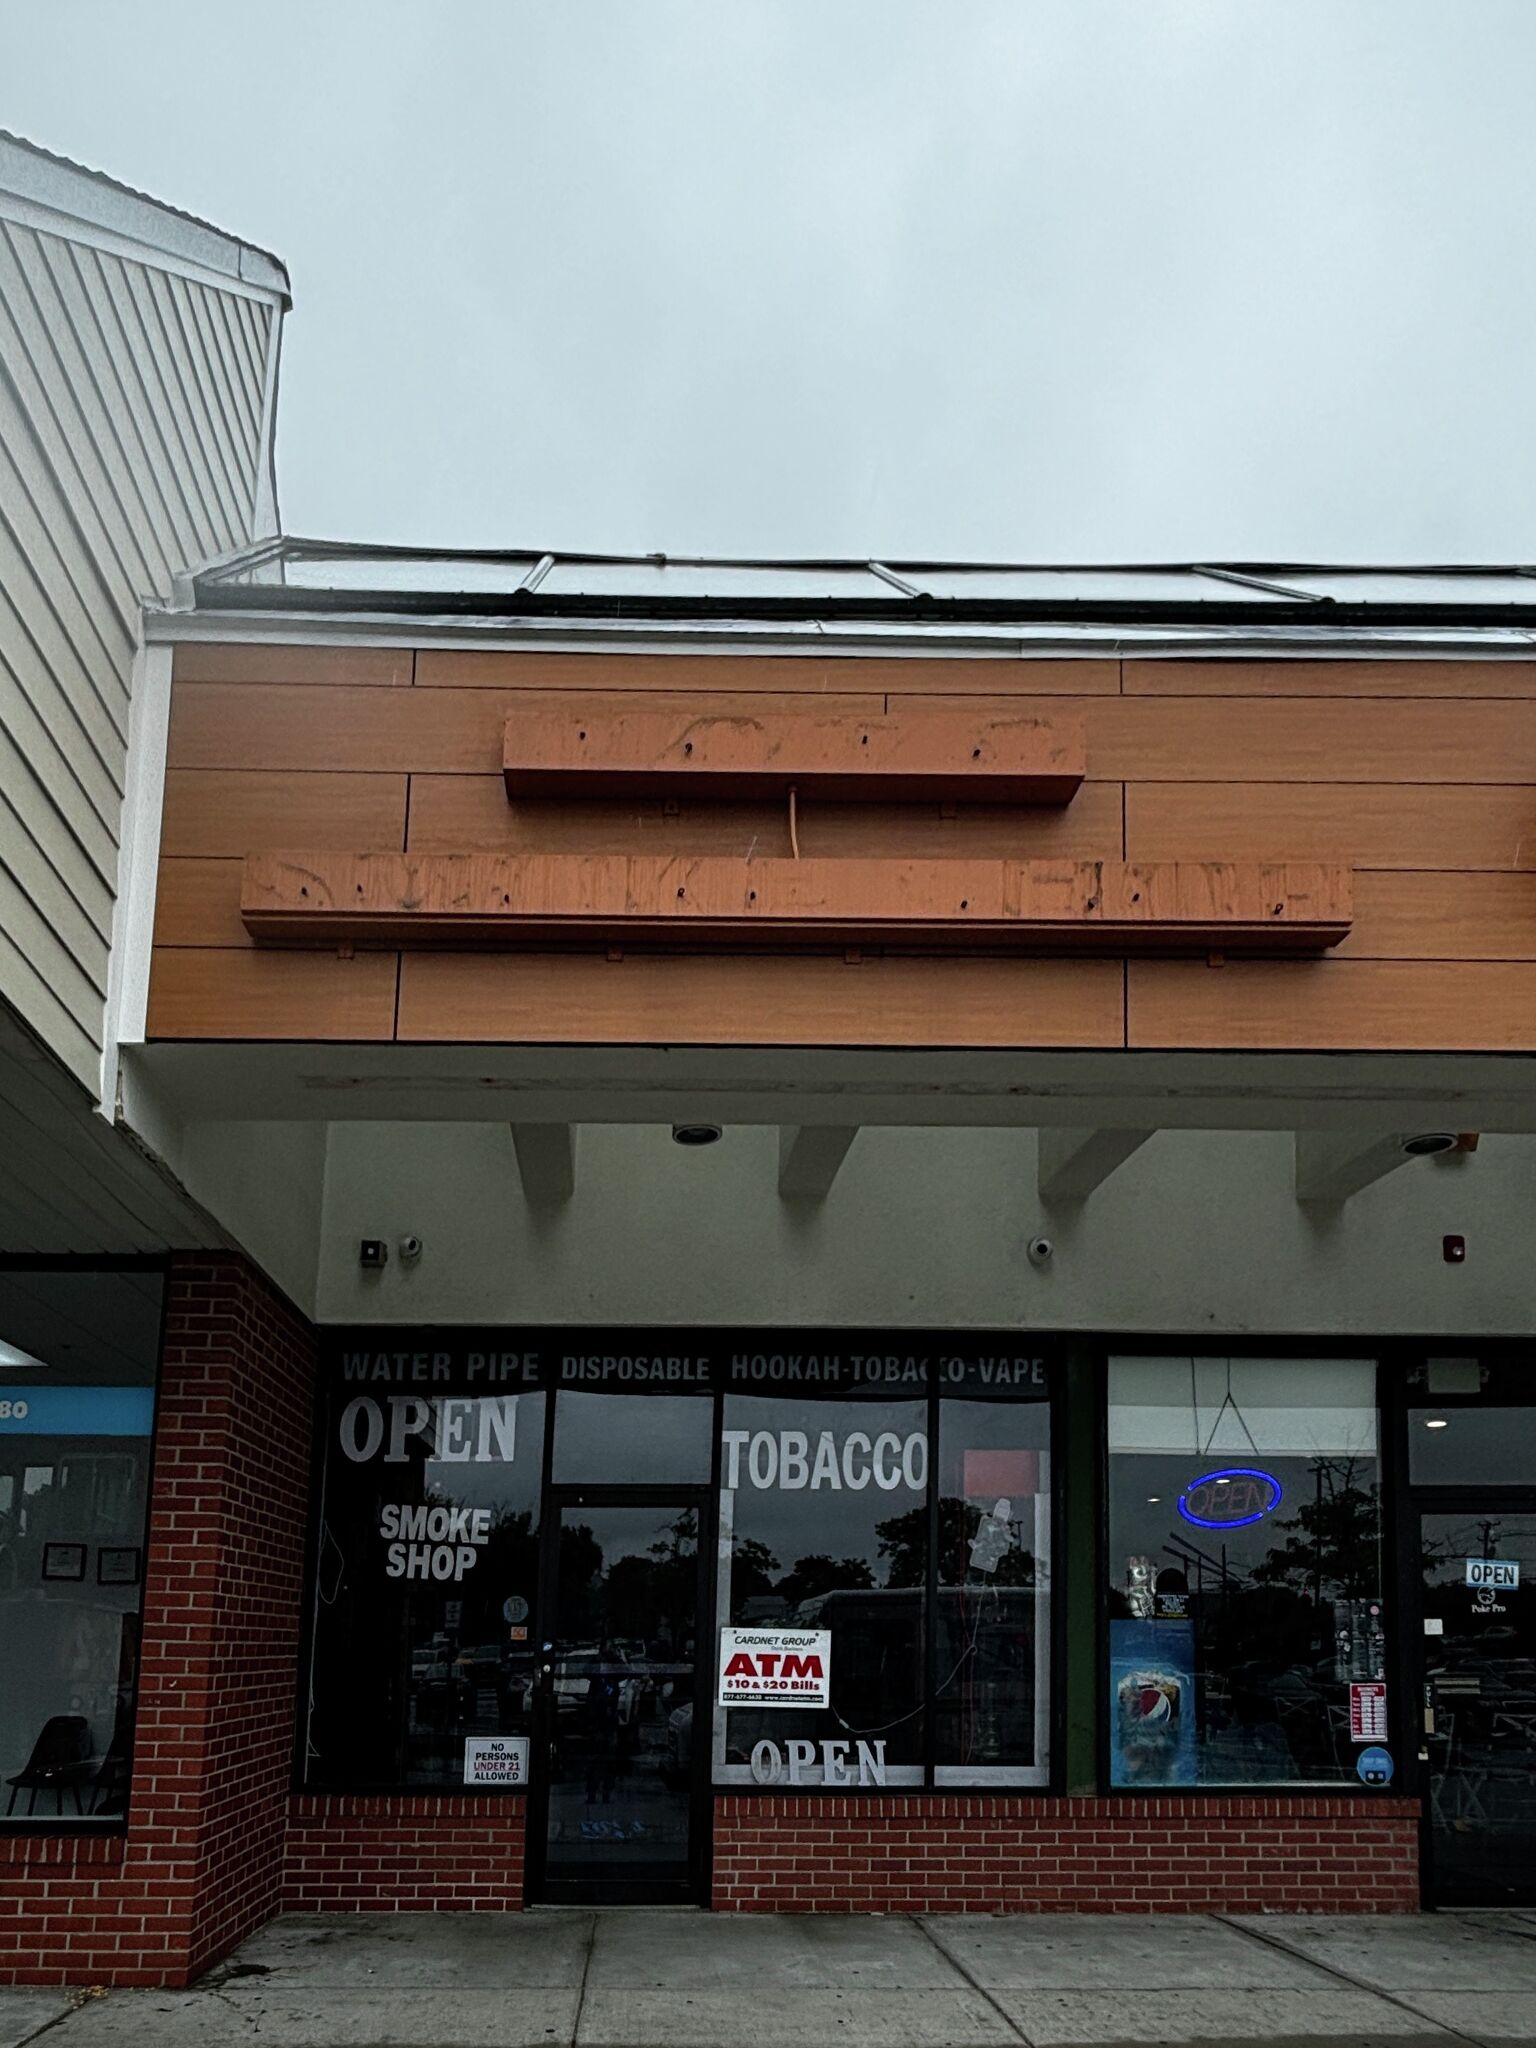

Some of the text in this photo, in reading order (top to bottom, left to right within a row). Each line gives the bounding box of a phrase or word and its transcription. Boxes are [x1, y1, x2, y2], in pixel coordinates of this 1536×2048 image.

[343, 1352, 451, 1381] WATER
[467, 1353, 539, 1381] PIPE
[562, 1356, 710, 1381] DISPOSABLE
[340, 1395, 519, 1463] OPEN
[722, 1430, 928, 1491] TOBACCO
[1188, 1481, 1266, 1516] OPEN
[380, 1504, 492, 1545] SMOKE
[386, 1544, 478, 1581] SHOP
[1471, 1564, 1514, 1584] OPEN
[735, 1636, 816, 1646] CARDNET GROUP
[723, 1653, 824, 1679] ATM
[727, 1680, 820, 1691] $10 & $20 Bills
[475, 1752, 519, 1761] PERSONS
[491, 1743, 505, 1752] NO
[474, 1762, 520, 1771] UNDER 21
[751, 1738, 887, 1787] OPEN
[474, 1772, 519, 1781] ALLOWED
